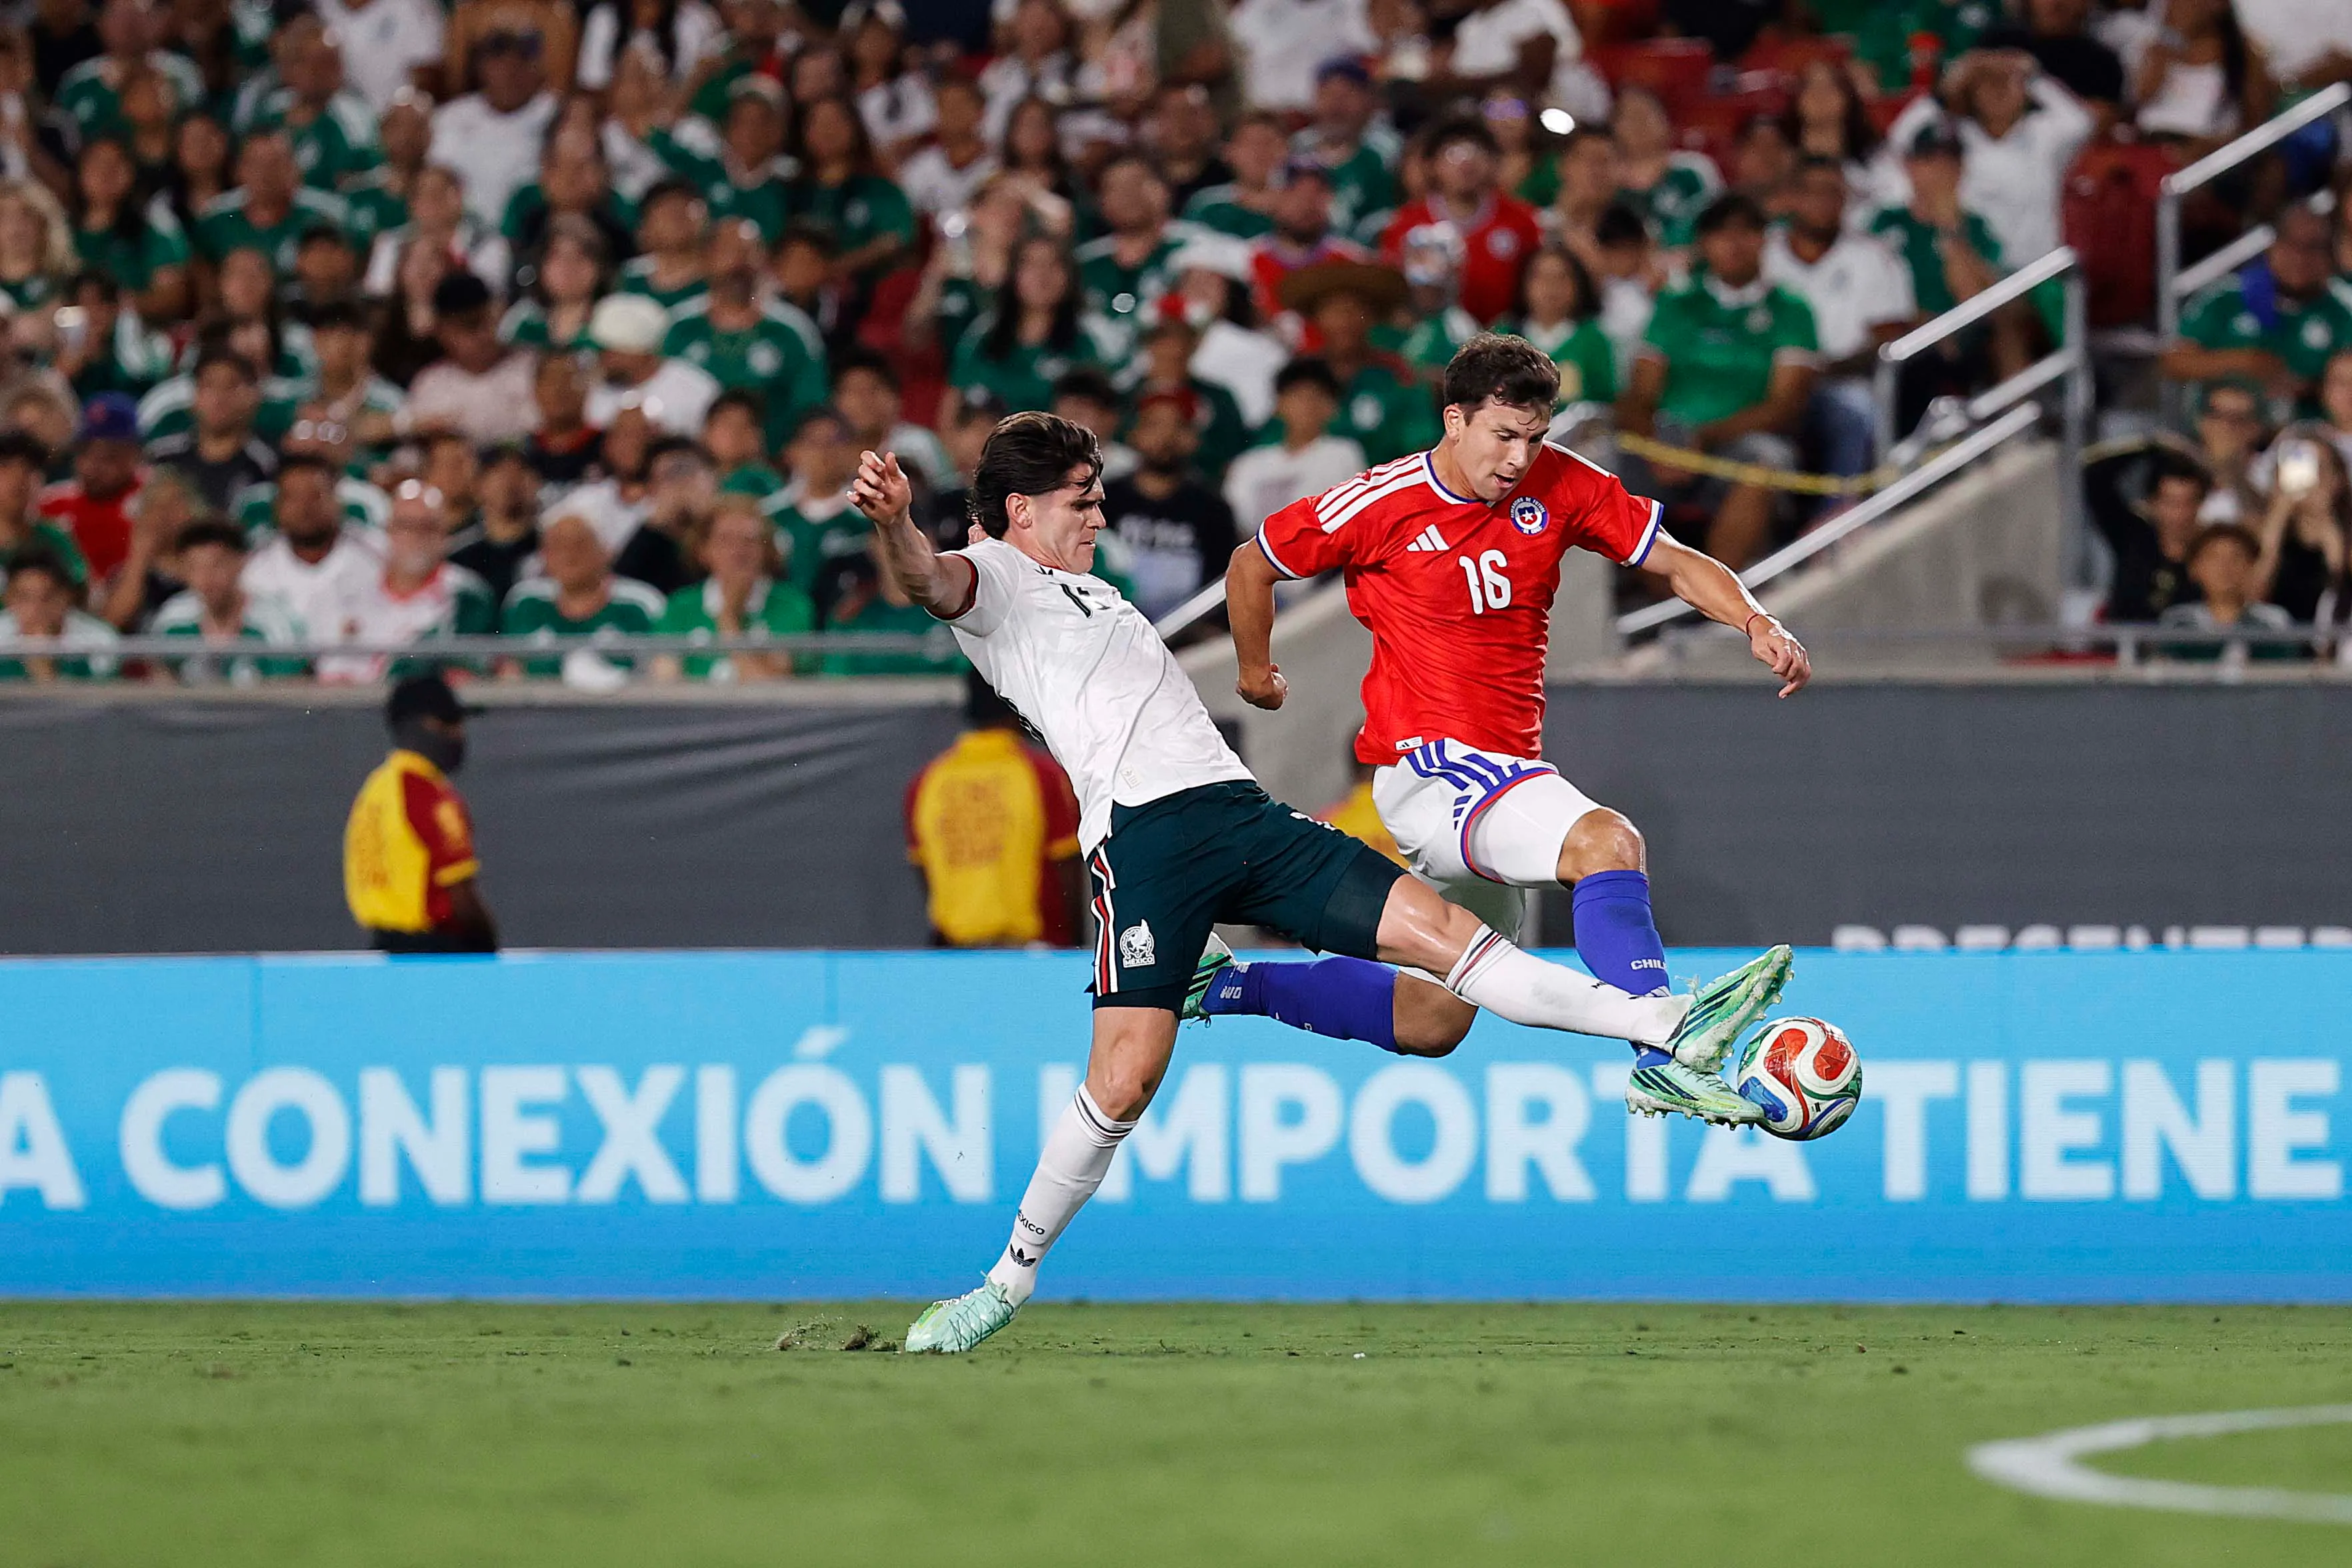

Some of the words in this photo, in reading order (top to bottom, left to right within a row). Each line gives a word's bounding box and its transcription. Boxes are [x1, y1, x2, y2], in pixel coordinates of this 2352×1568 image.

[1459, 549, 1511, 615] 16
[1631, 959, 1666, 971] CHIL
[119, 1025, 993, 1207] CONEXIÓN
[1039, 1061, 1817, 1203] IMPORTA
[1857, 1059, 2343, 1201] TIENE
